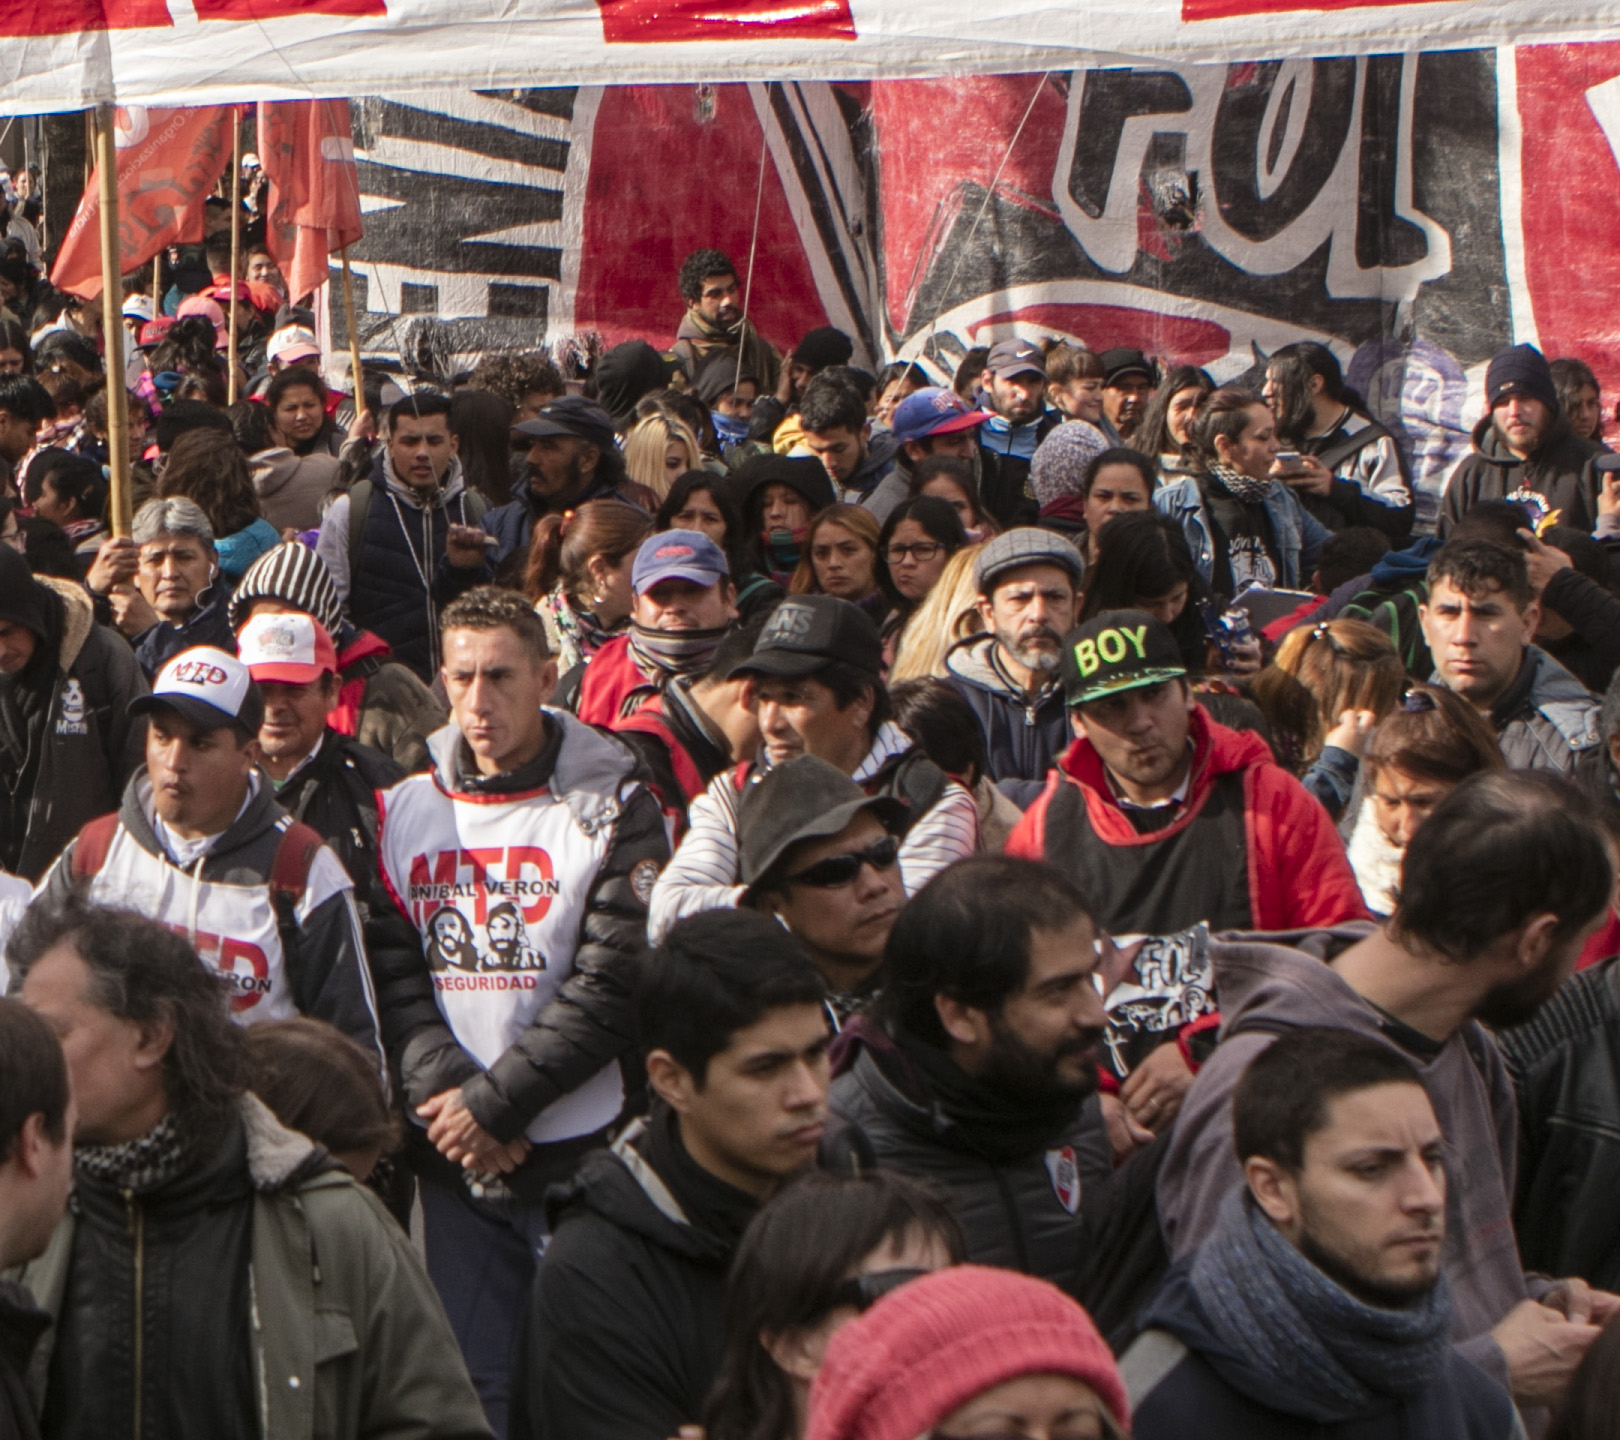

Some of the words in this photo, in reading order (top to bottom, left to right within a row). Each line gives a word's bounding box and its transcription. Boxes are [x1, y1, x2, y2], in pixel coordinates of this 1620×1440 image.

[1073, 624, 1148, 678] BOY
[407, 845, 554, 930] MTD
[410, 883, 478, 901] ANIBAL
[483, 879, 561, 897] VERON
[434, 974, 537, 991] SEGURIDAD
